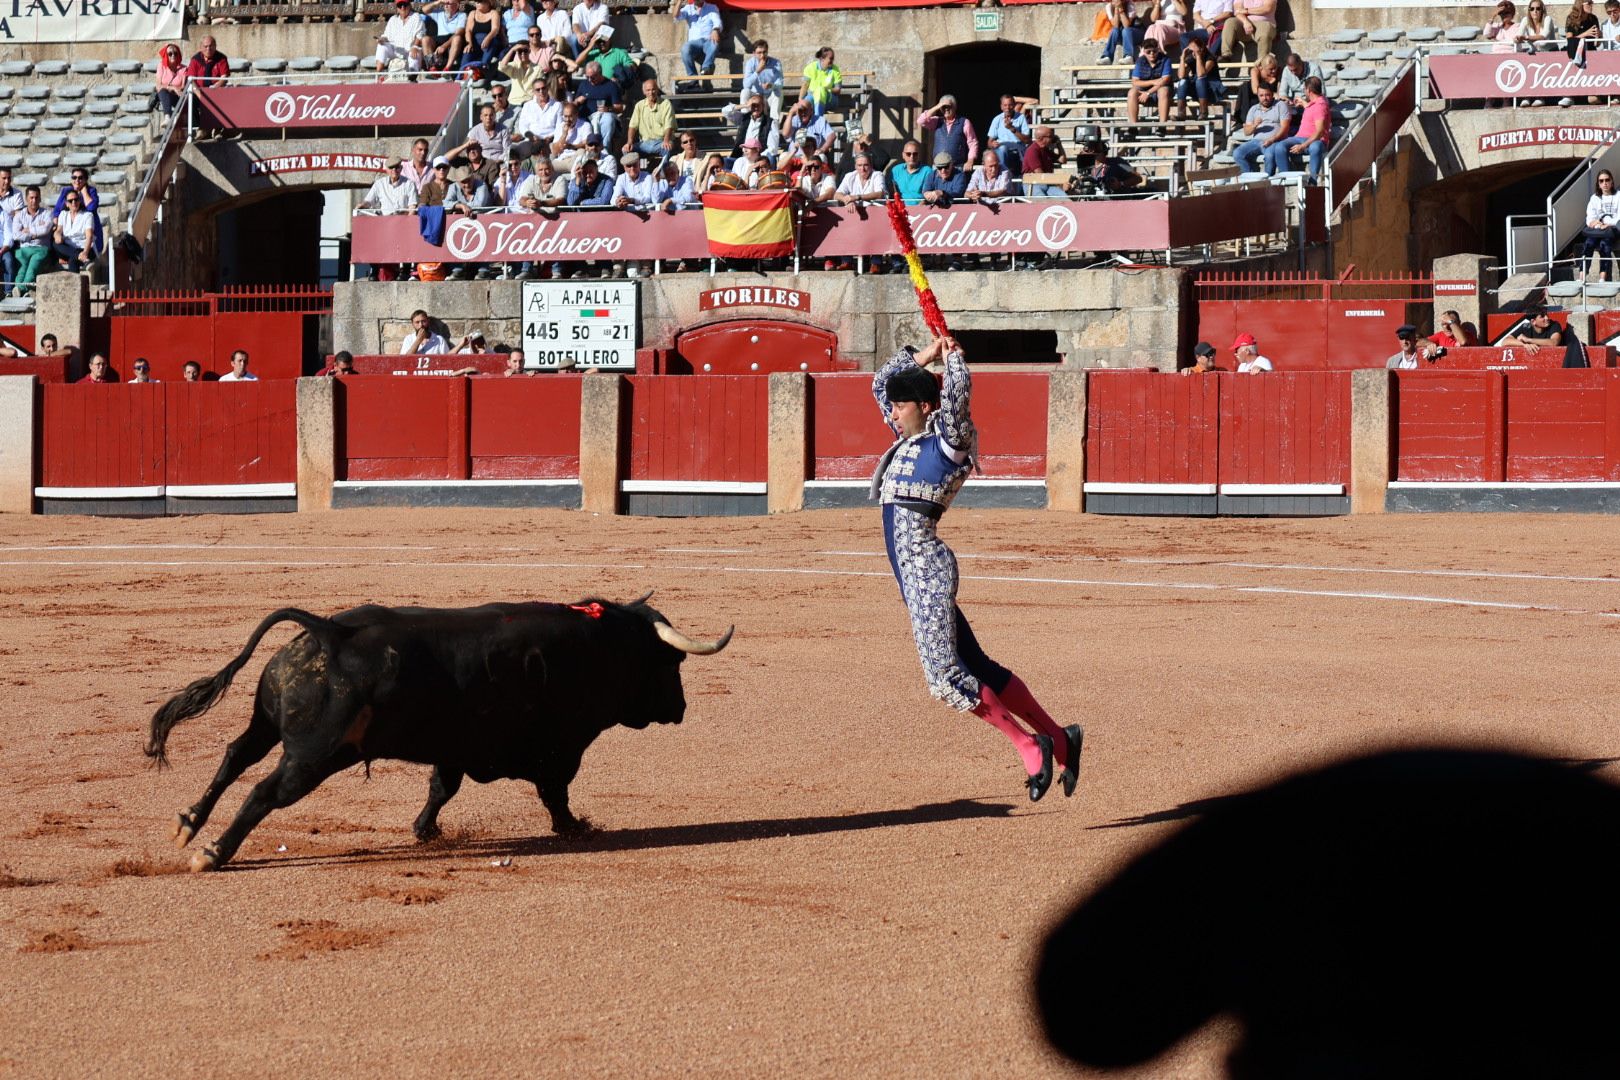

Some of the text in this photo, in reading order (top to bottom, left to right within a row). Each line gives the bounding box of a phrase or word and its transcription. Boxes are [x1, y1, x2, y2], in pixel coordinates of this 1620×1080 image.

[976, 16, 997, 28] SALIDA
[1527, 61, 1620, 89] Valduer
[297, 93, 396, 120] Valduero
[1481, 130, 1534, 150] PUERTA
[1538, 128, 1555, 141] DE
[251, 156, 307, 173] PUERTA
[312, 156, 330, 168] DE
[488, 219, 622, 255] Valduero
[562, 289, 621, 305] A.PALLA
[710, 288, 800, 308] TORILES
[526, 322, 559, 340] 445
[572, 325, 590, 340] 50
[612, 325, 629, 340] 21
[416, 357, 430, 369] 12
